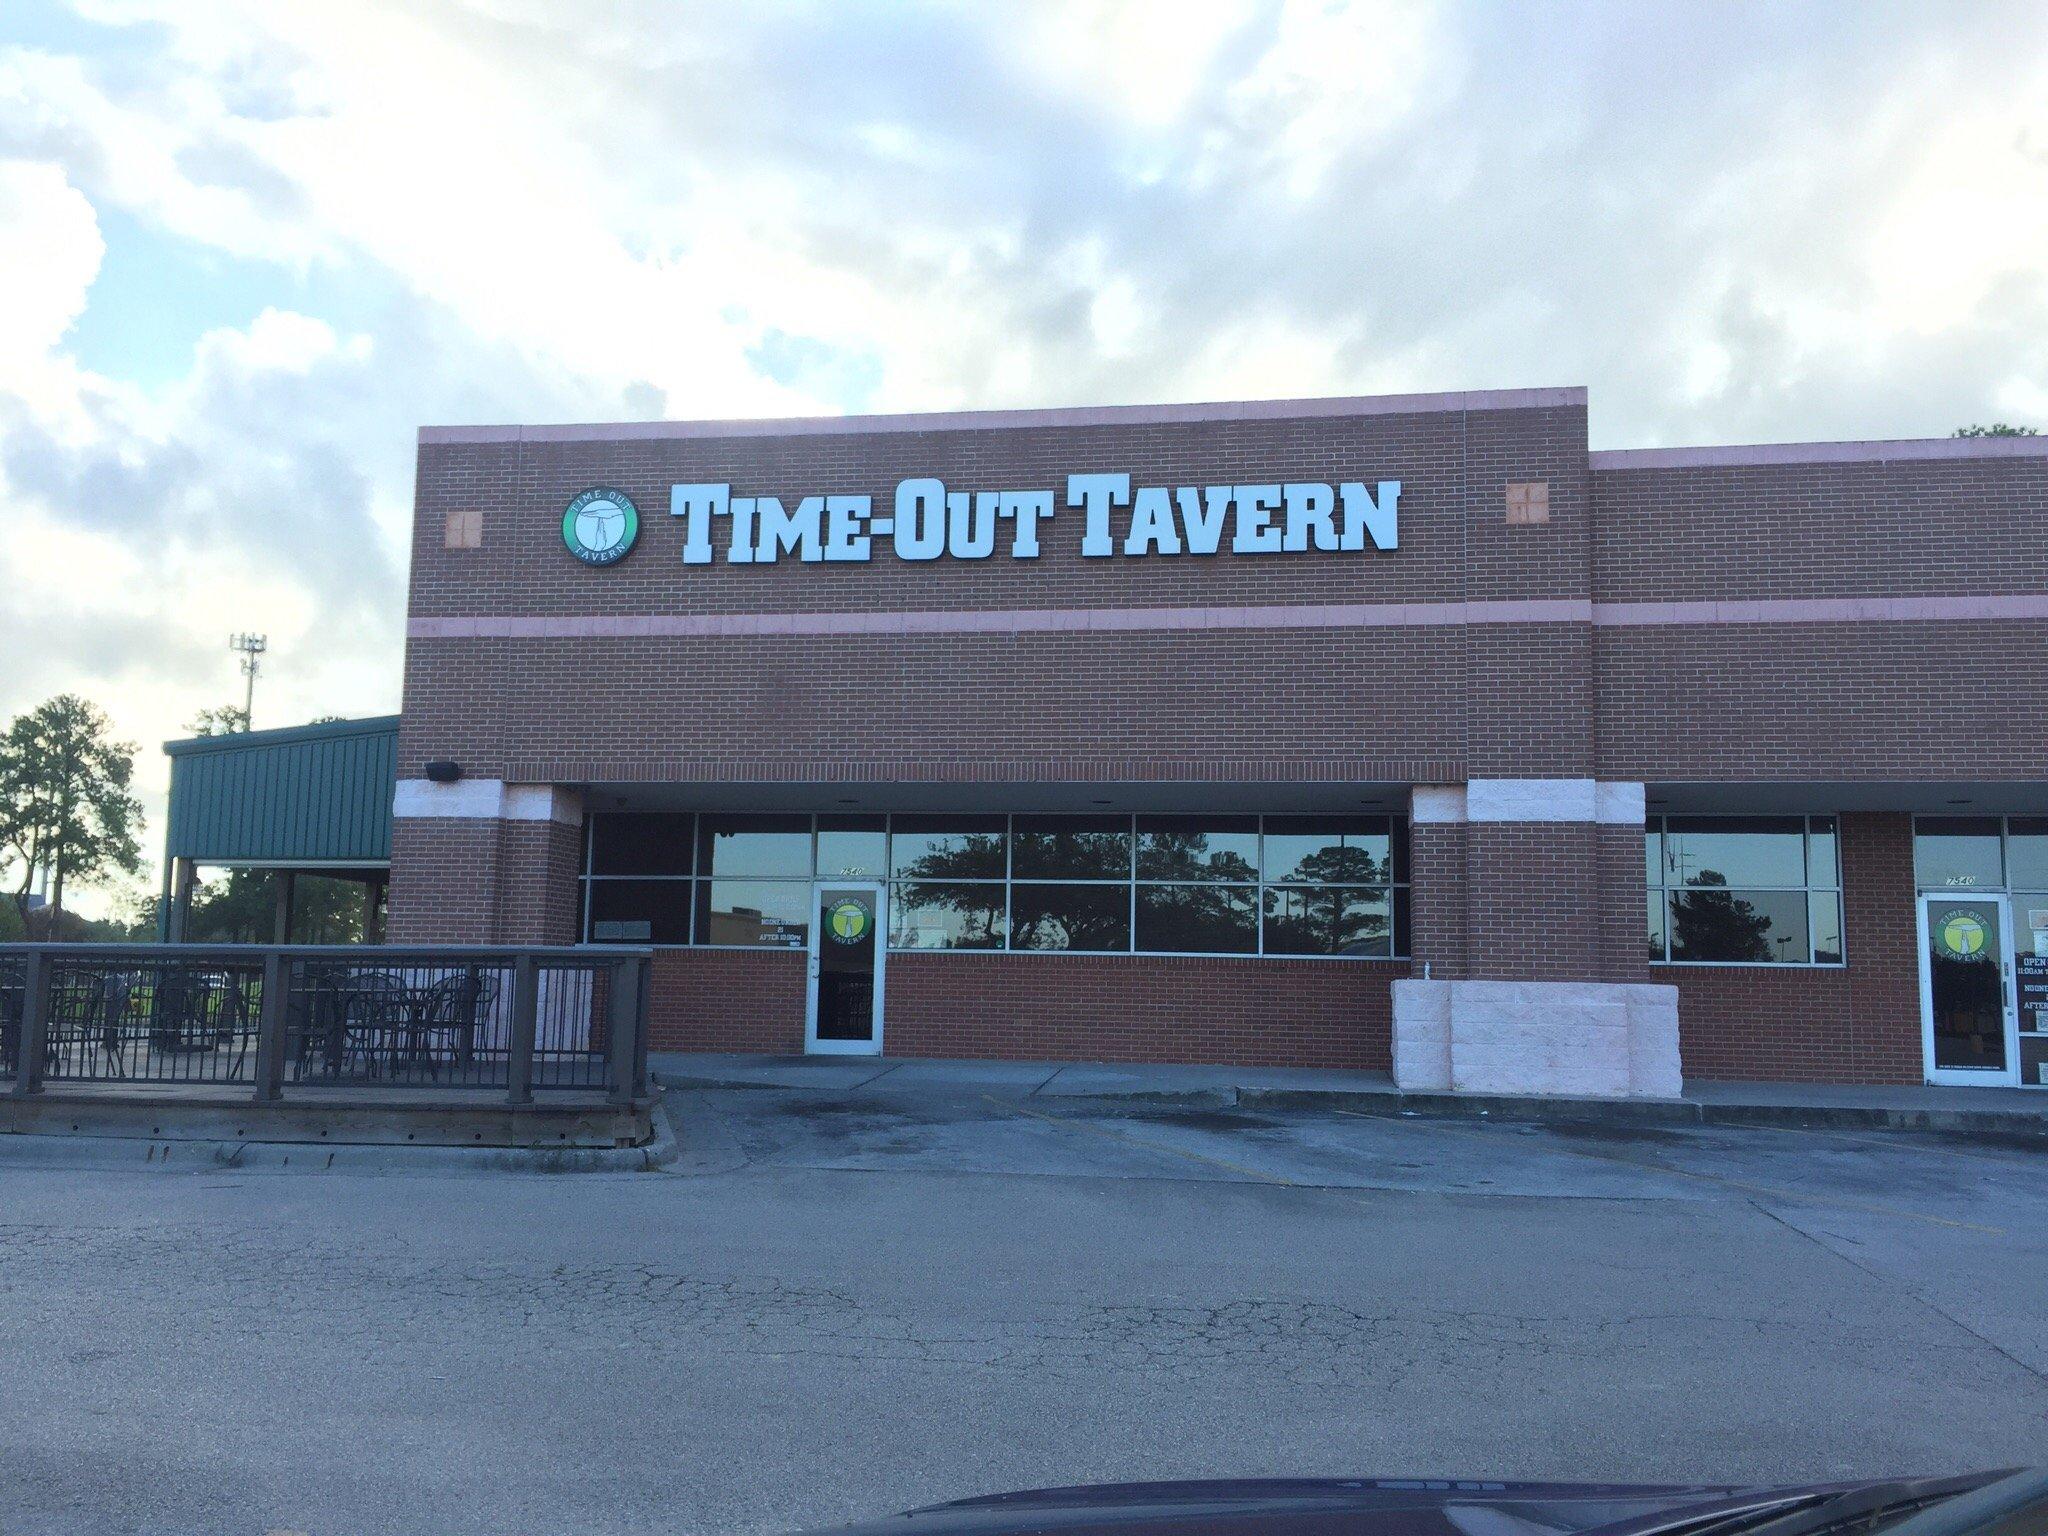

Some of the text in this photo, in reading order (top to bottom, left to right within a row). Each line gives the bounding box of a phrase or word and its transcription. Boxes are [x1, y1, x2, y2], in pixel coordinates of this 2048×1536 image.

[570, 490, 631, 513] TIME OUT
[1067, 473, 1401, 557] TAVERN
[575, 542, 626, 561] TAVERN
[840, 867, 863, 875] 7540
[1946, 876, 1976, 885] 7540
[830, 898, 869, 912] TIME OUT
[1940, 910, 1987, 926] TIME OUT
[832, 932, 866, 945] TAVERN
[1946, 948, 1986, 962] TAVERN
[2023, 957, 2046, 966] OPEN
